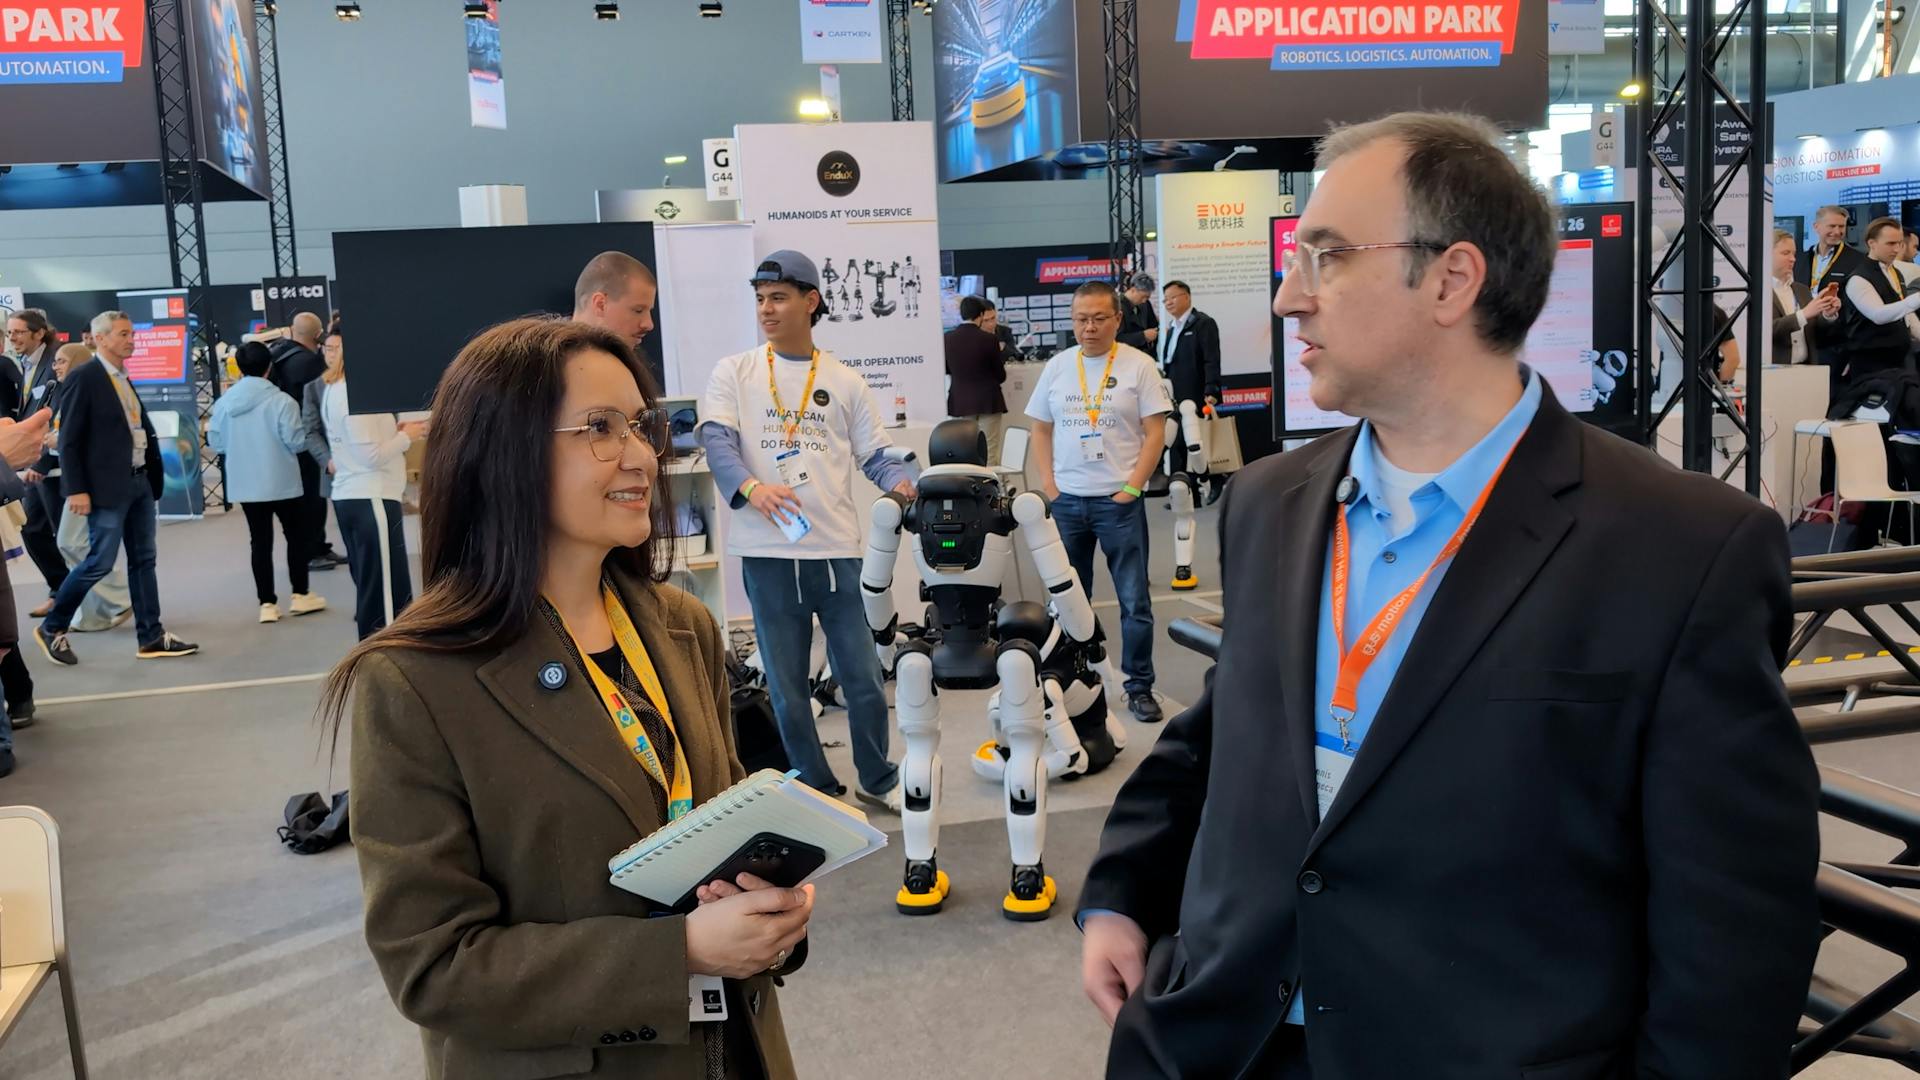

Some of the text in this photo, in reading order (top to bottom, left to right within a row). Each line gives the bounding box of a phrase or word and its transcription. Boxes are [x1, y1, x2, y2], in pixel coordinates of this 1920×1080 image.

[2, 8, 124, 42] PARK
[1210, 5, 1503, 37] APPLICATION PARK
[1281, 48, 1492, 64] ROBOTICS. LOGISTICS. AUTOMATION.
[1599, 121, 1612, 138] G
[713, 149, 729, 168] G
[712, 172, 733, 182] G44
[824, 171, 853, 180] EnduX
[1774, 170, 1824, 185] OGISTICS
[1283, 202, 1292, 213] G
[768, 208, 912, 220] HUMANOIDS AT YOUR SERVICE
[1198, 218, 1245, 230] 意优科技
[1567, 218, 1585, 231] 26
[1044, 265, 1106, 277] APPLICATION
[839, 355, 924, 368] OUR OPERATIONS
[802, 410, 825, 422] CAN
[1073, 419, 1090, 427] FOR
[1097, 419, 1117, 427] OU?
[761, 440, 776, 449] DO
[780, 440, 800, 449] FOR
[1377, 593, 1409, 632] motion
